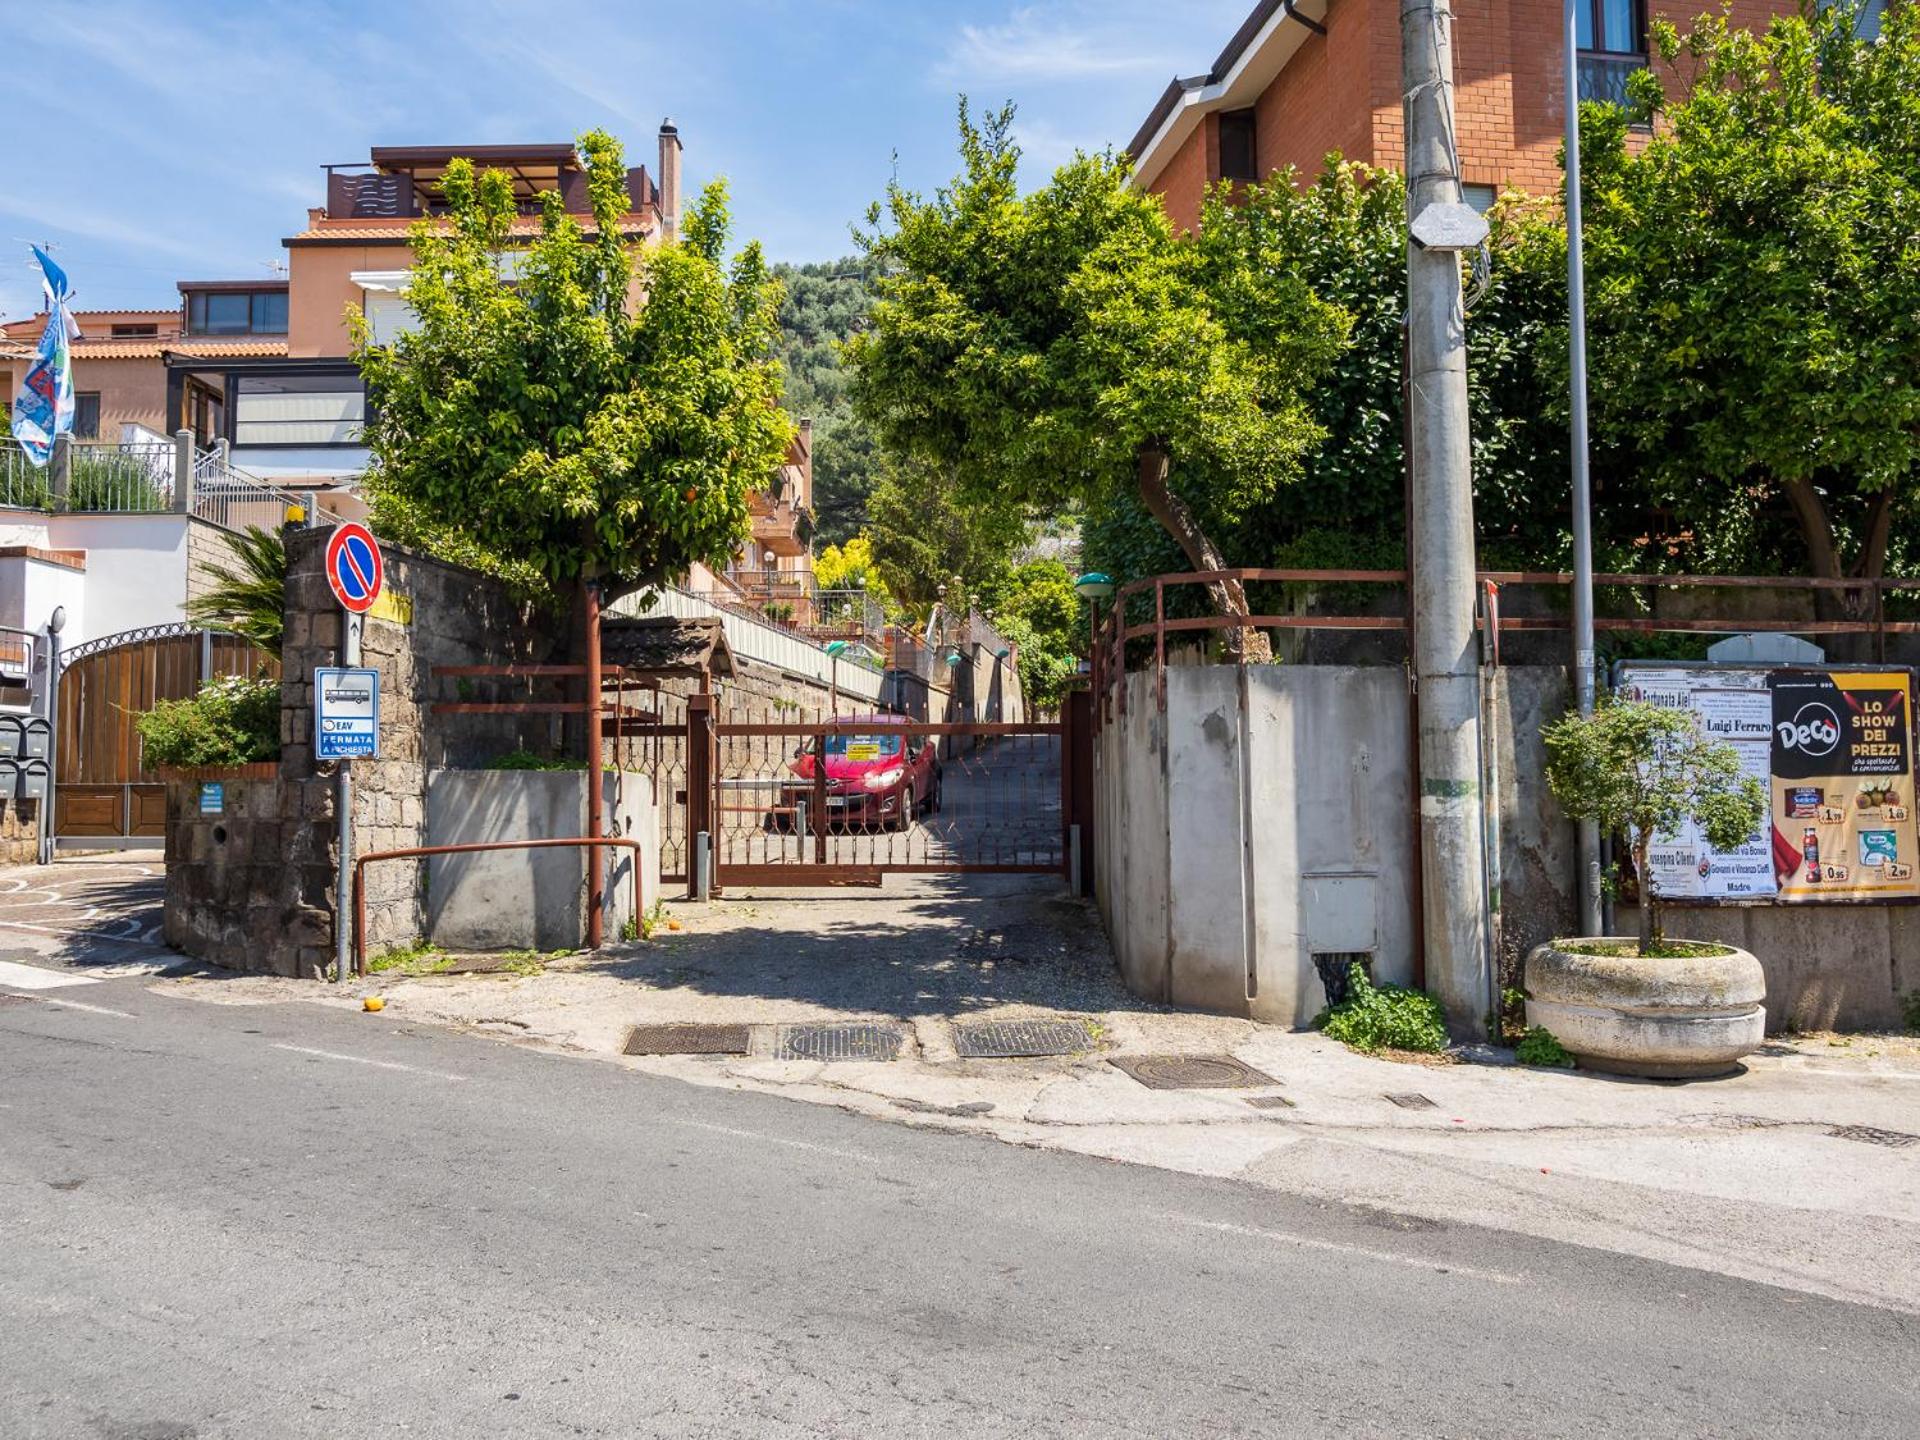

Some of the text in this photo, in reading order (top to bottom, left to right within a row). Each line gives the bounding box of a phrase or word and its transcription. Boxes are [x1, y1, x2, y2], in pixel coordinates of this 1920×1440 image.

[1863, 701, 1882, 713] LO
[336, 721, 353, 730] EAV
[1706, 718, 1771, 733] Luigi Ferraro
[1851, 715, 1896, 728] SHOW
[323, 735, 373, 744] FERMATA
[1863, 729, 1886, 742] DEI
[323, 746, 330, 754] A
[1851, 743, 1900, 756] PREZZI
[1727, 883, 1751, 892] Madre
